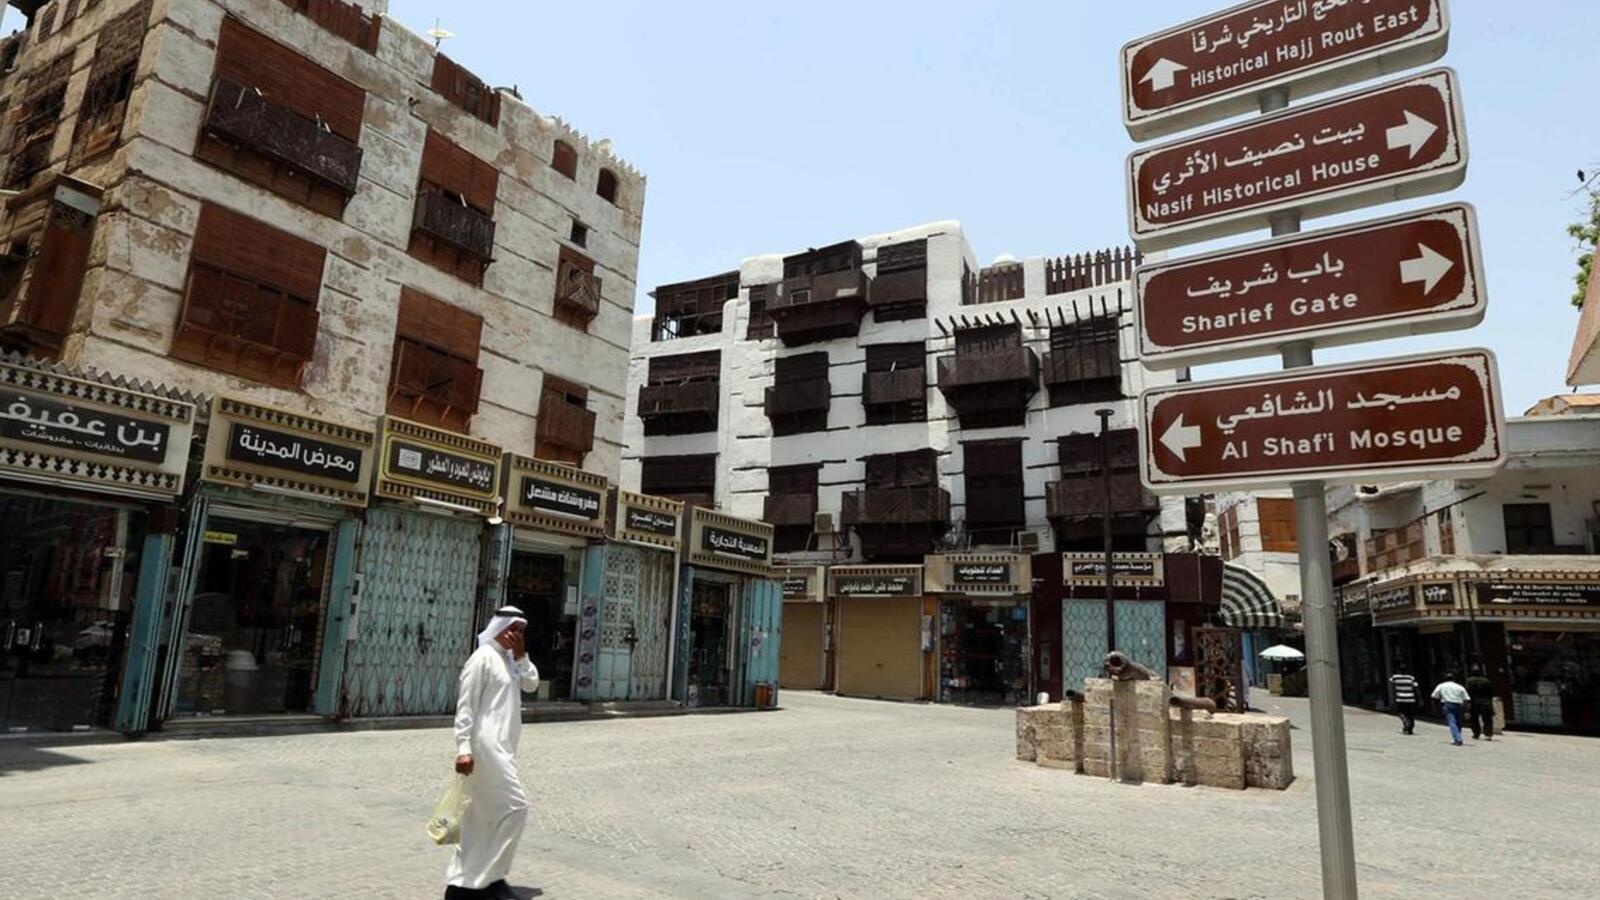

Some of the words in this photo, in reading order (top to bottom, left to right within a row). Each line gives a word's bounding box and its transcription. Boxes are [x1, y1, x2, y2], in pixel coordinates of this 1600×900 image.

[1190, 52, 1268, 88] Historical
[1276, 37, 1314, 61] Hajj
[1321, 22, 1365, 49] Rout
[1373, 5, 1419, 33] East
[1224, 132, 1305, 166] نصيف
[1312, 122, 1365, 145] بيت
[1147, 194, 1194, 220] Nasif
[1202, 169, 1301, 207] Historical
[1312, 152, 1380, 182] House
[1152, 150, 1217, 195] الأثري
[1186, 262, 1279, 298] شريف
[1287, 251, 1344, 283] باب
[1182, 302, 1274, 333] Sharief
[1290, 292, 1358, 316] Gate
[1216, 388, 1334, 435] الشافعي
[1347, 385, 1462, 411] مسجد
[117, 421, 162, 451] بن
[240, 428, 300, 459] المدينة
[1221, 441, 1248, 460] Al
[1263, 432, 1335, 456] Shaf'i
[1350, 425, 1463, 450] Mosque
[303, 447, 355, 472] معرض
[527, 484, 557, 501] مشعل
[558, 490, 598, 510] مفروشات
